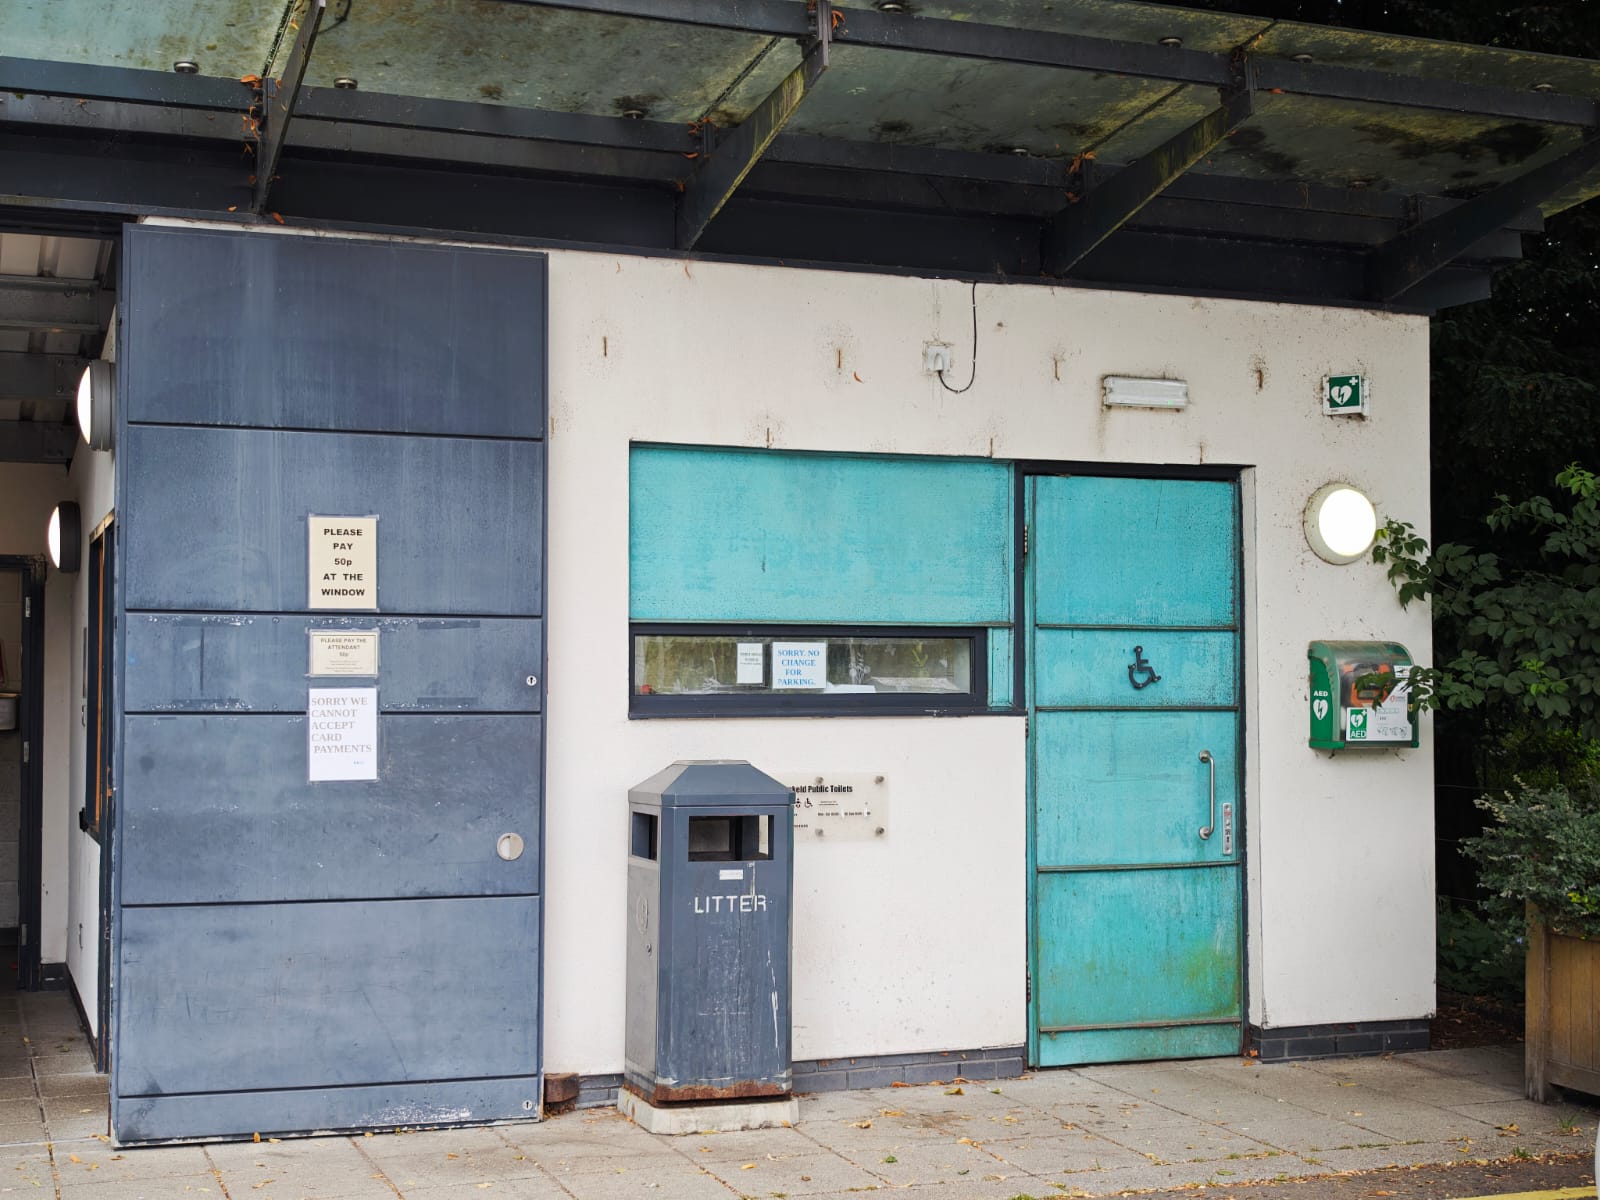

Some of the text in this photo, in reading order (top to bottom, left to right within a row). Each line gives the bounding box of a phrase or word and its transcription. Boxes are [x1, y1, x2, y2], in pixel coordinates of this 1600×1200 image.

[324, 528, 363, 536] PLEASE
[333, 542, 353, 550] PAY
[334, 558, 352, 567] 50p
[343, 573, 363, 581] THE
[321, 588, 365, 596] WINDOW
[808, 649, 820, 657] NO
[781, 659, 816, 667] CHANGE
[785, 668, 802, 676] FOR
[311, 697, 368, 706] SORRY WE
[311, 709, 358, 718] CANNOT
[311, 721, 355, 730] ACCEPT
[311, 733, 342, 742] CARD
[1350, 730, 1367, 738] AED
[314, 744, 372, 753] PAYMENTS
[808, 785, 829, 793] Public
[830, 784, 853, 793] Toilets
[694, 894, 767, 913] LITTER
